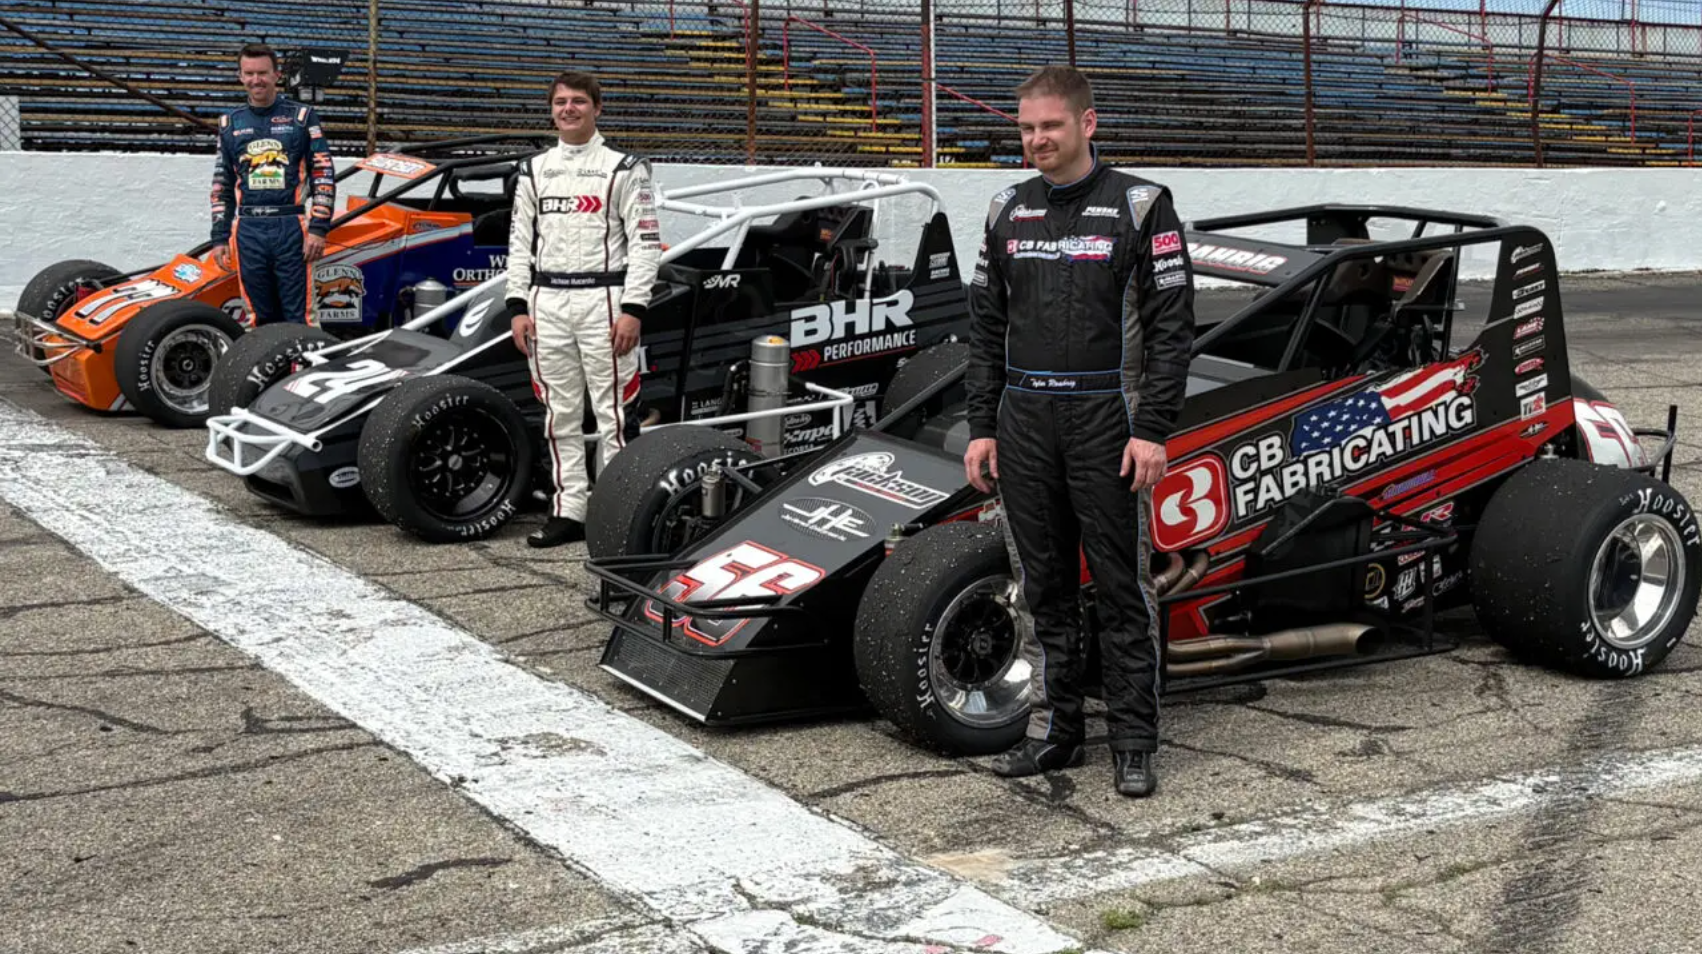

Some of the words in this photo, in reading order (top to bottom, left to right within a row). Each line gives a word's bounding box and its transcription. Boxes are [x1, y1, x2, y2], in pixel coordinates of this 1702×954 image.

[542, 198, 579, 212] BHR
[1019, 240, 1034, 250] CB
[1036, 240, 1114, 251] FABRICATING
[1153, 233, 1179, 249] 500
[317, 266, 357, 279] GLENN
[42, 276, 84, 319] oosier
[320, 310, 356, 319] FARMS
[790, 289, 914, 348] BHR
[138, 340, 156, 392] Hoosier
[247, 340, 326, 393] Hoosier
[823, 329, 917, 362] PERFORMANCE
[284, 359, 410, 404] 24
[411, 393, 470, 430] Hoosier
[1231, 434, 1283, 479] CB
[1235, 395, 1474, 518] FABRICATING
[460, 499, 517, 537] Hoosier
[783, 503, 870, 537] JHE
[1632, 488, 1700, 546] Hoosier
[915, 622, 934, 709] Hoosier
[1579, 621, 1648, 676] Hoosier
